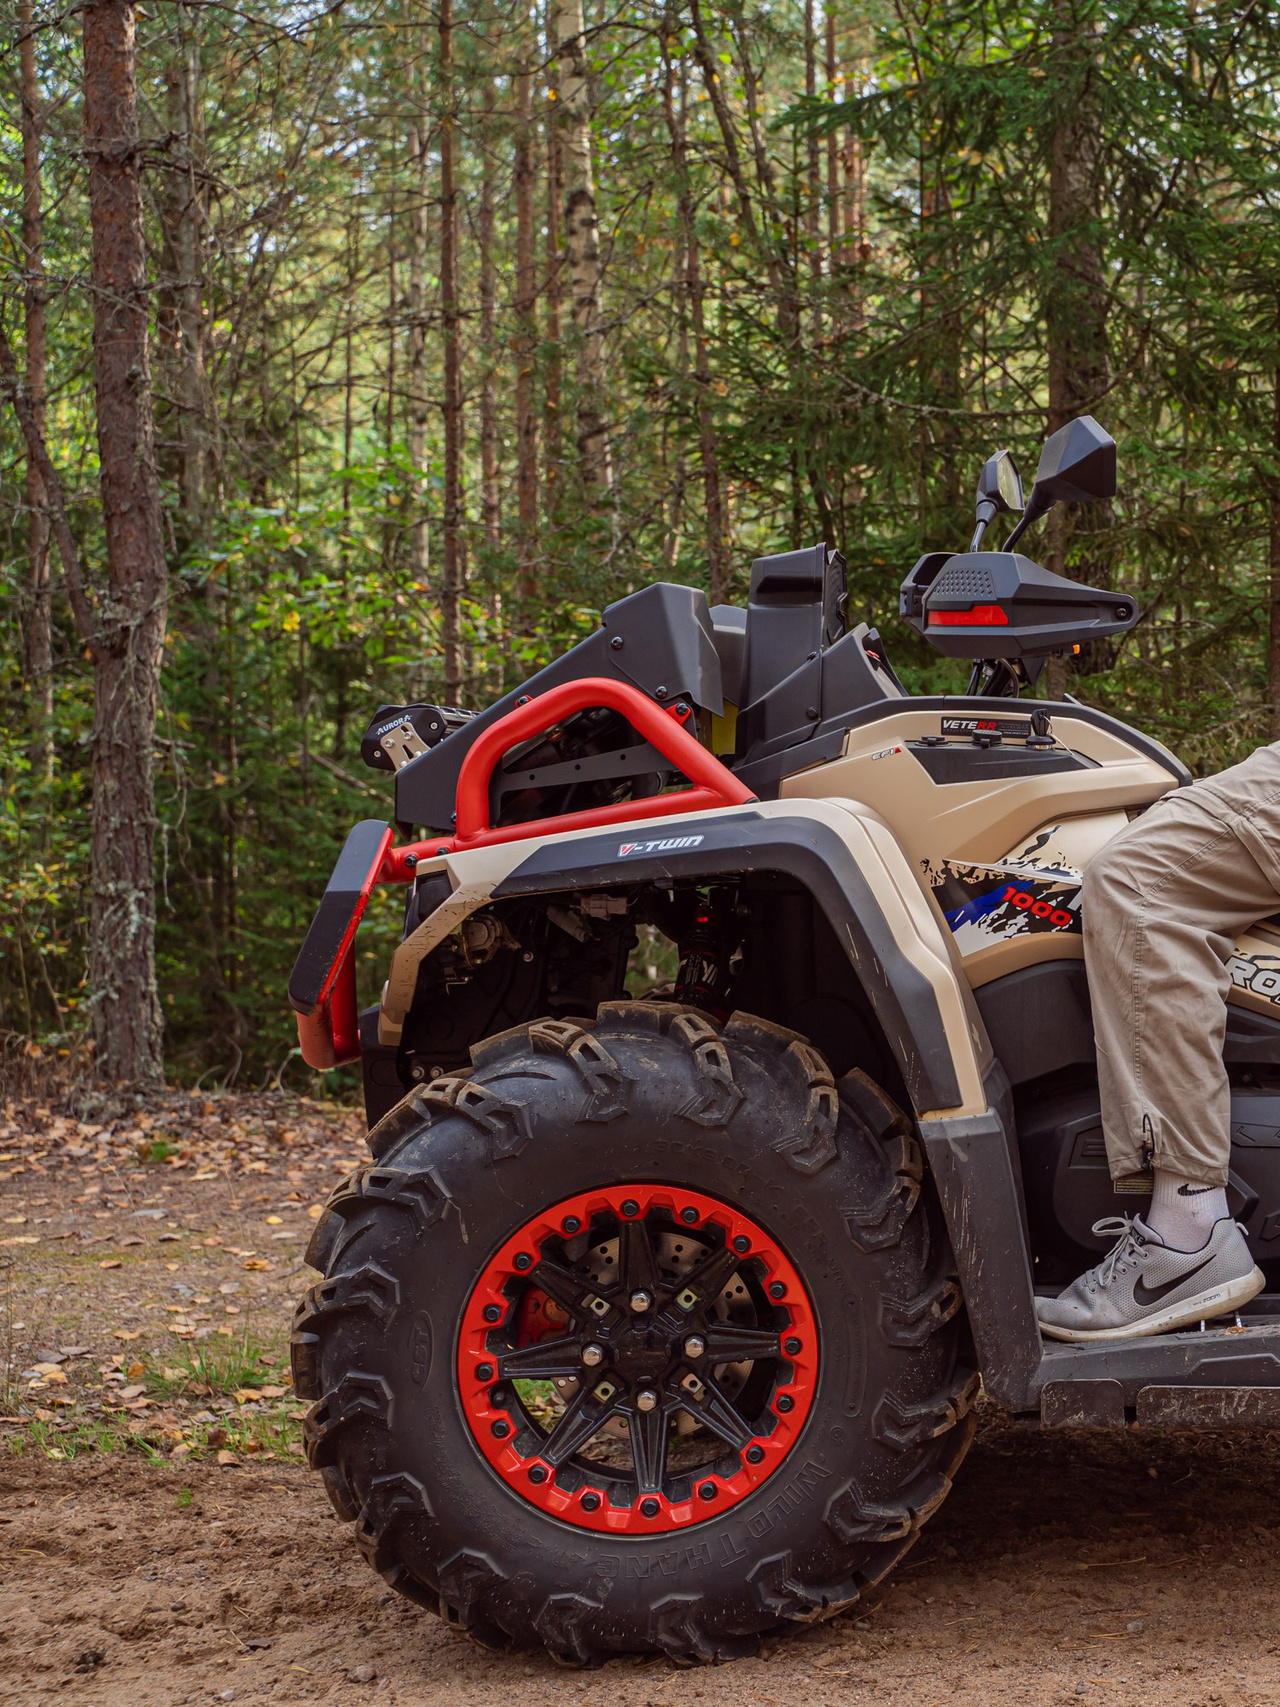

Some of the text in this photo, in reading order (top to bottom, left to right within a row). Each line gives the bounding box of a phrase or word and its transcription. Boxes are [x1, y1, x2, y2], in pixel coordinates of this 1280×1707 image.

[375, 714, 413, 736] AURORA
[942, 719, 998, 731] VETERR
[871, 748, 895, 761] EFI
[618, 835, 704, 857] V-TWIN
[1001, 886, 1073, 927] 1000
[407, 1324, 429, 1385] CST
[746, 1461, 834, 1539] WILD
[596, 1532, 750, 1579] THANG
